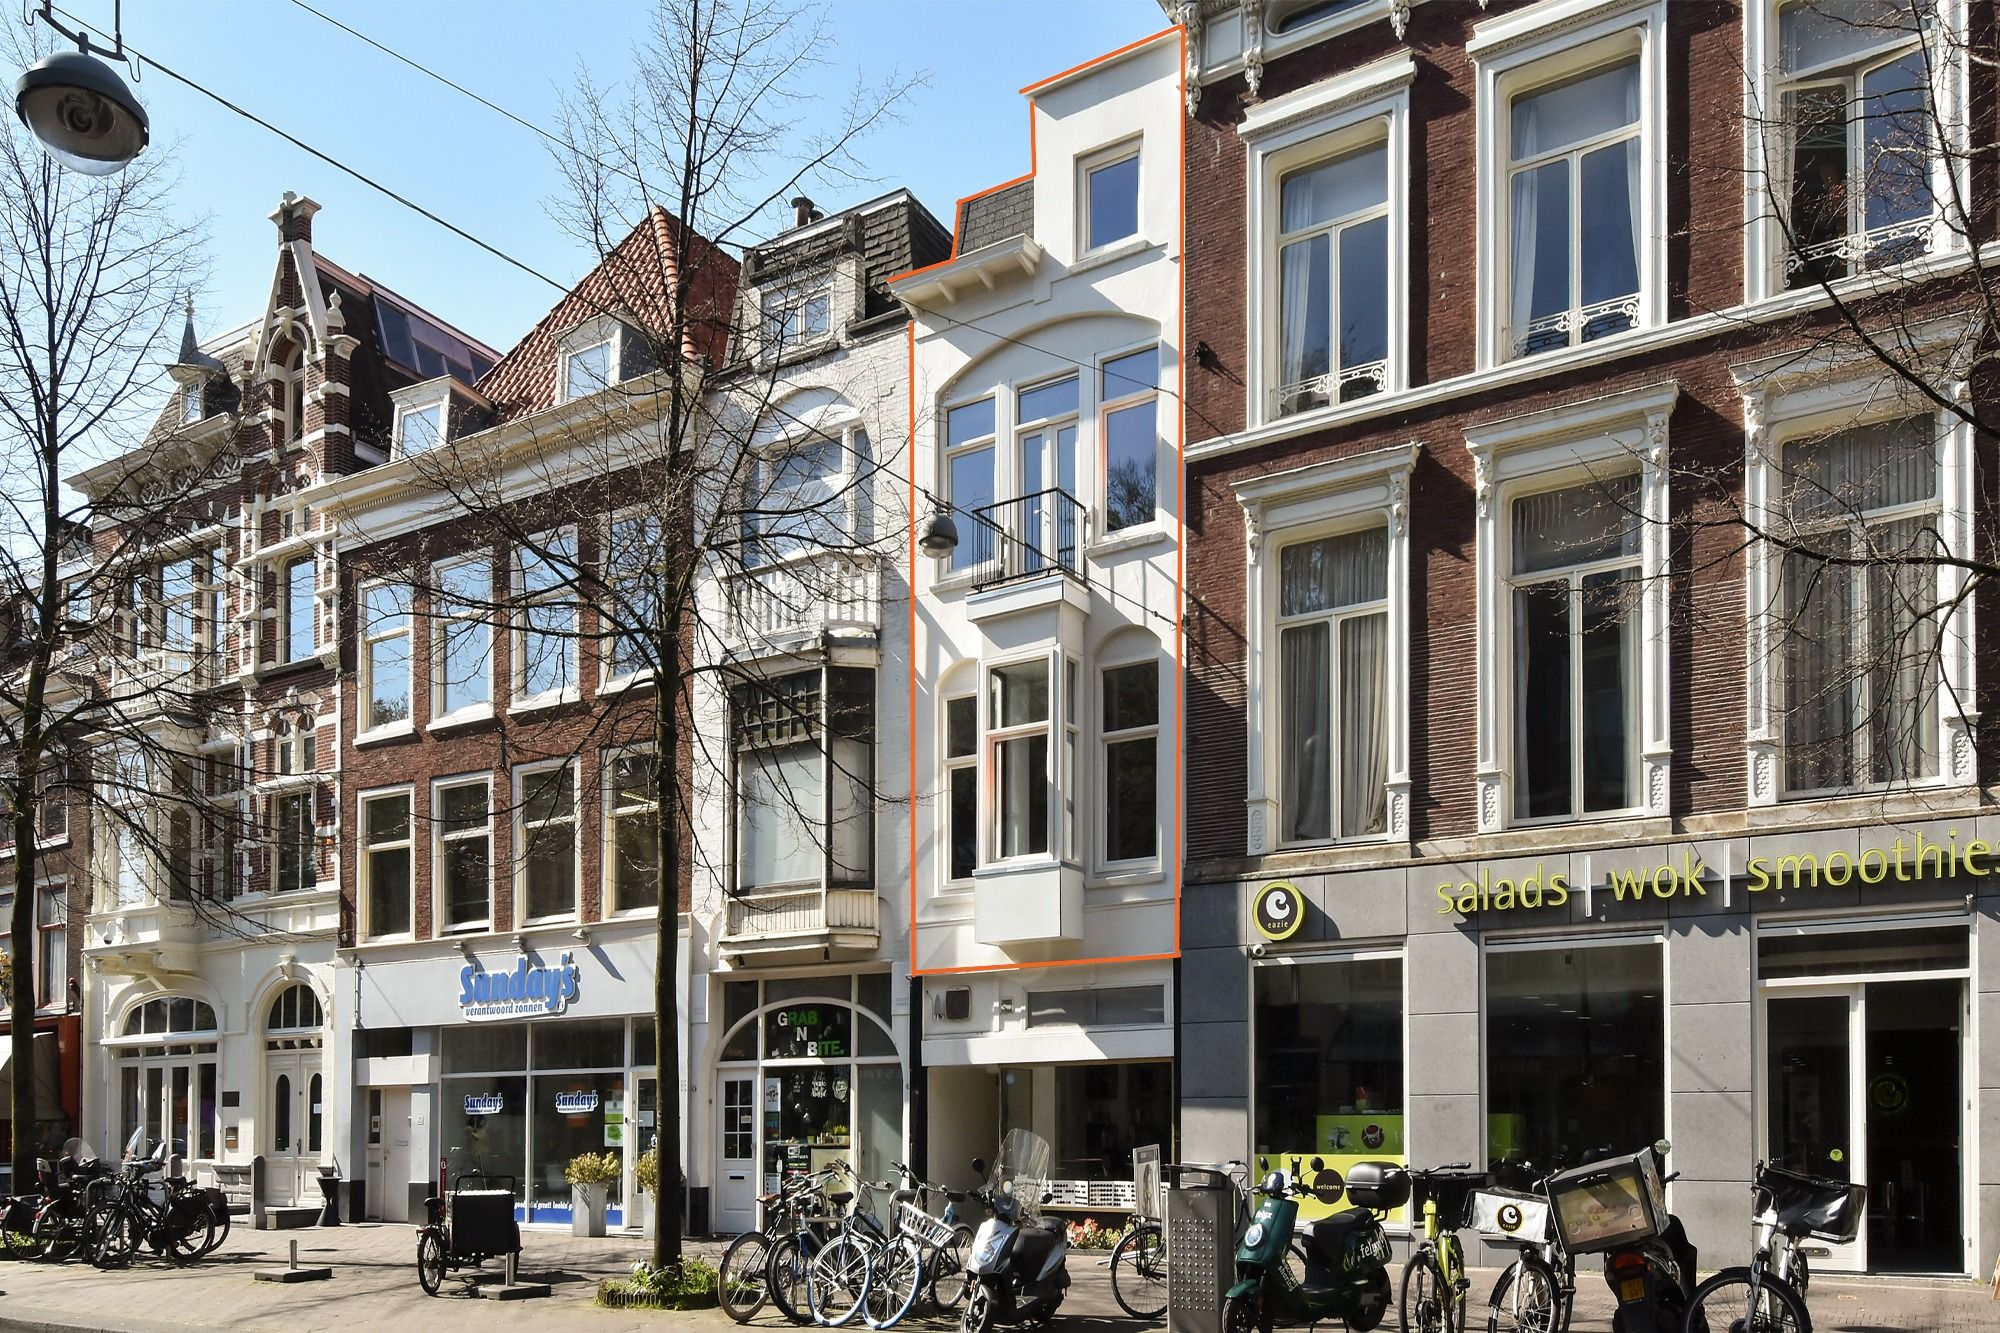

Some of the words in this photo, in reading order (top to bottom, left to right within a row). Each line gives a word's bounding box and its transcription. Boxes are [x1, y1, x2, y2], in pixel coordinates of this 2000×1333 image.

[1435, 863, 1568, 914] salads
[1611, 851, 1707, 901] wok
[1747, 828, 2000, 892] smoothie
[1267, 920, 1289, 929] eazie
[460, 953, 575, 1010] Sunday's
[465, 1003, 513, 1016] verantwoord
[514, 1003, 543, 1014] zonnen
[777, 1011, 819, 1027] GRAB
[796, 1026, 808, 1041] N
[464, 1093, 503, 1111] Sunday's
[556, 1090, 598, 1110] Sunday's
